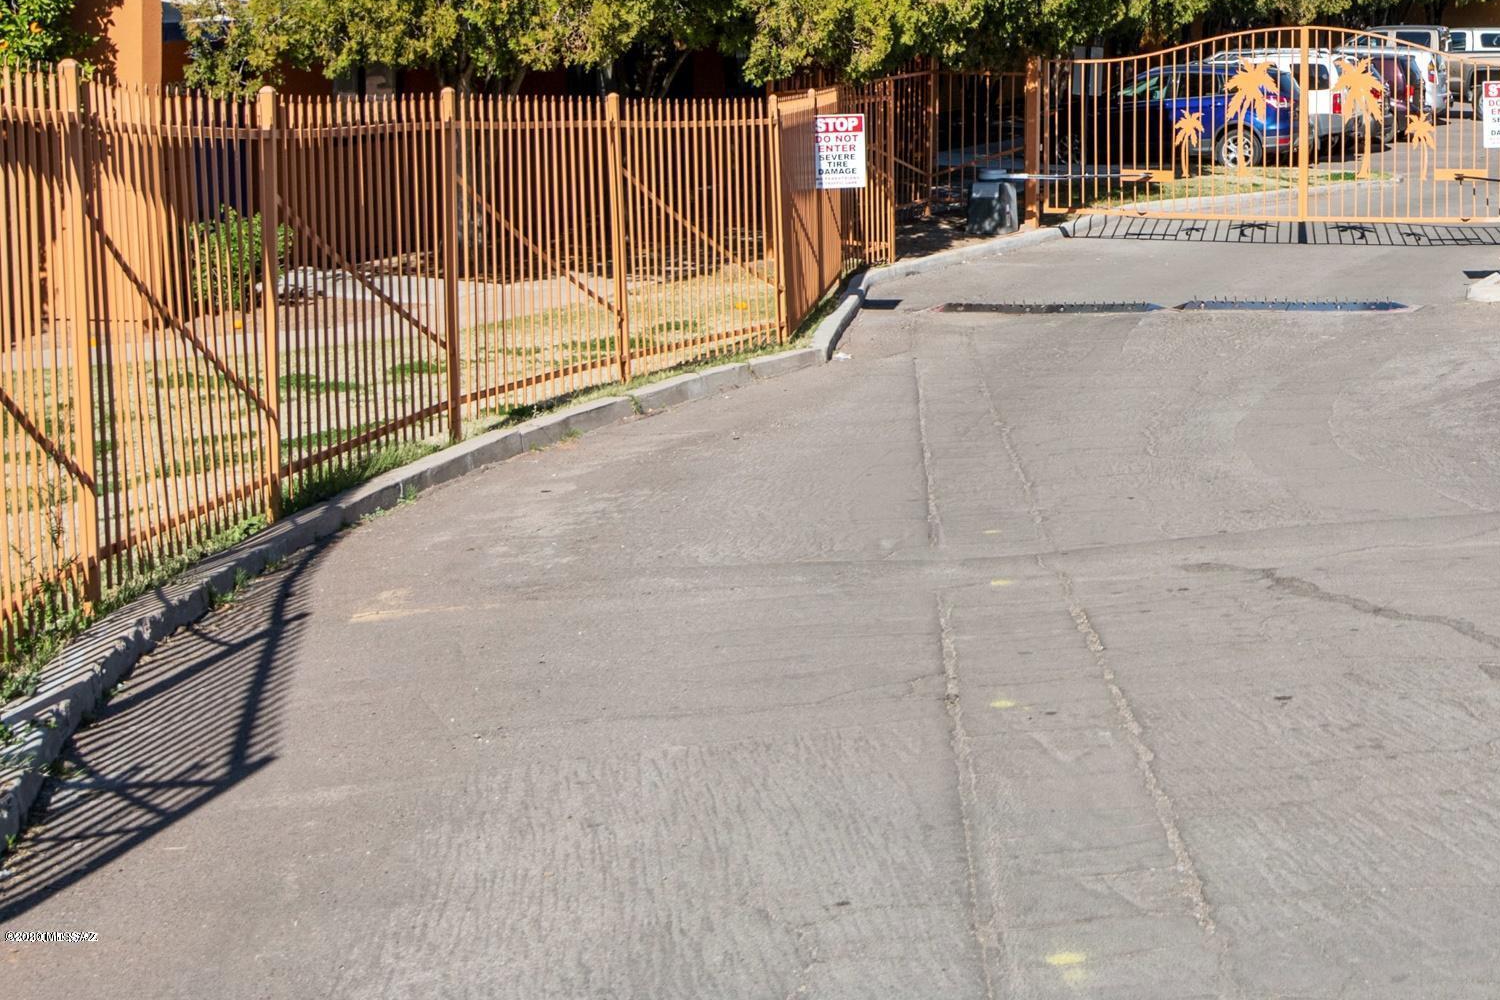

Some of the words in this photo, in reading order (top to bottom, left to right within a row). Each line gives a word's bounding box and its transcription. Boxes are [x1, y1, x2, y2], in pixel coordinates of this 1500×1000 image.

[816, 117, 858, 132] STOP
[816, 135, 831, 143] DO
[835, 134, 858, 142] NOT
[818, 144, 856, 153] ENTER
[818, 153, 856, 161] SEVERE
[827, 160, 848, 168] TIRE
[818, 167, 857, 175] DAMAGE
